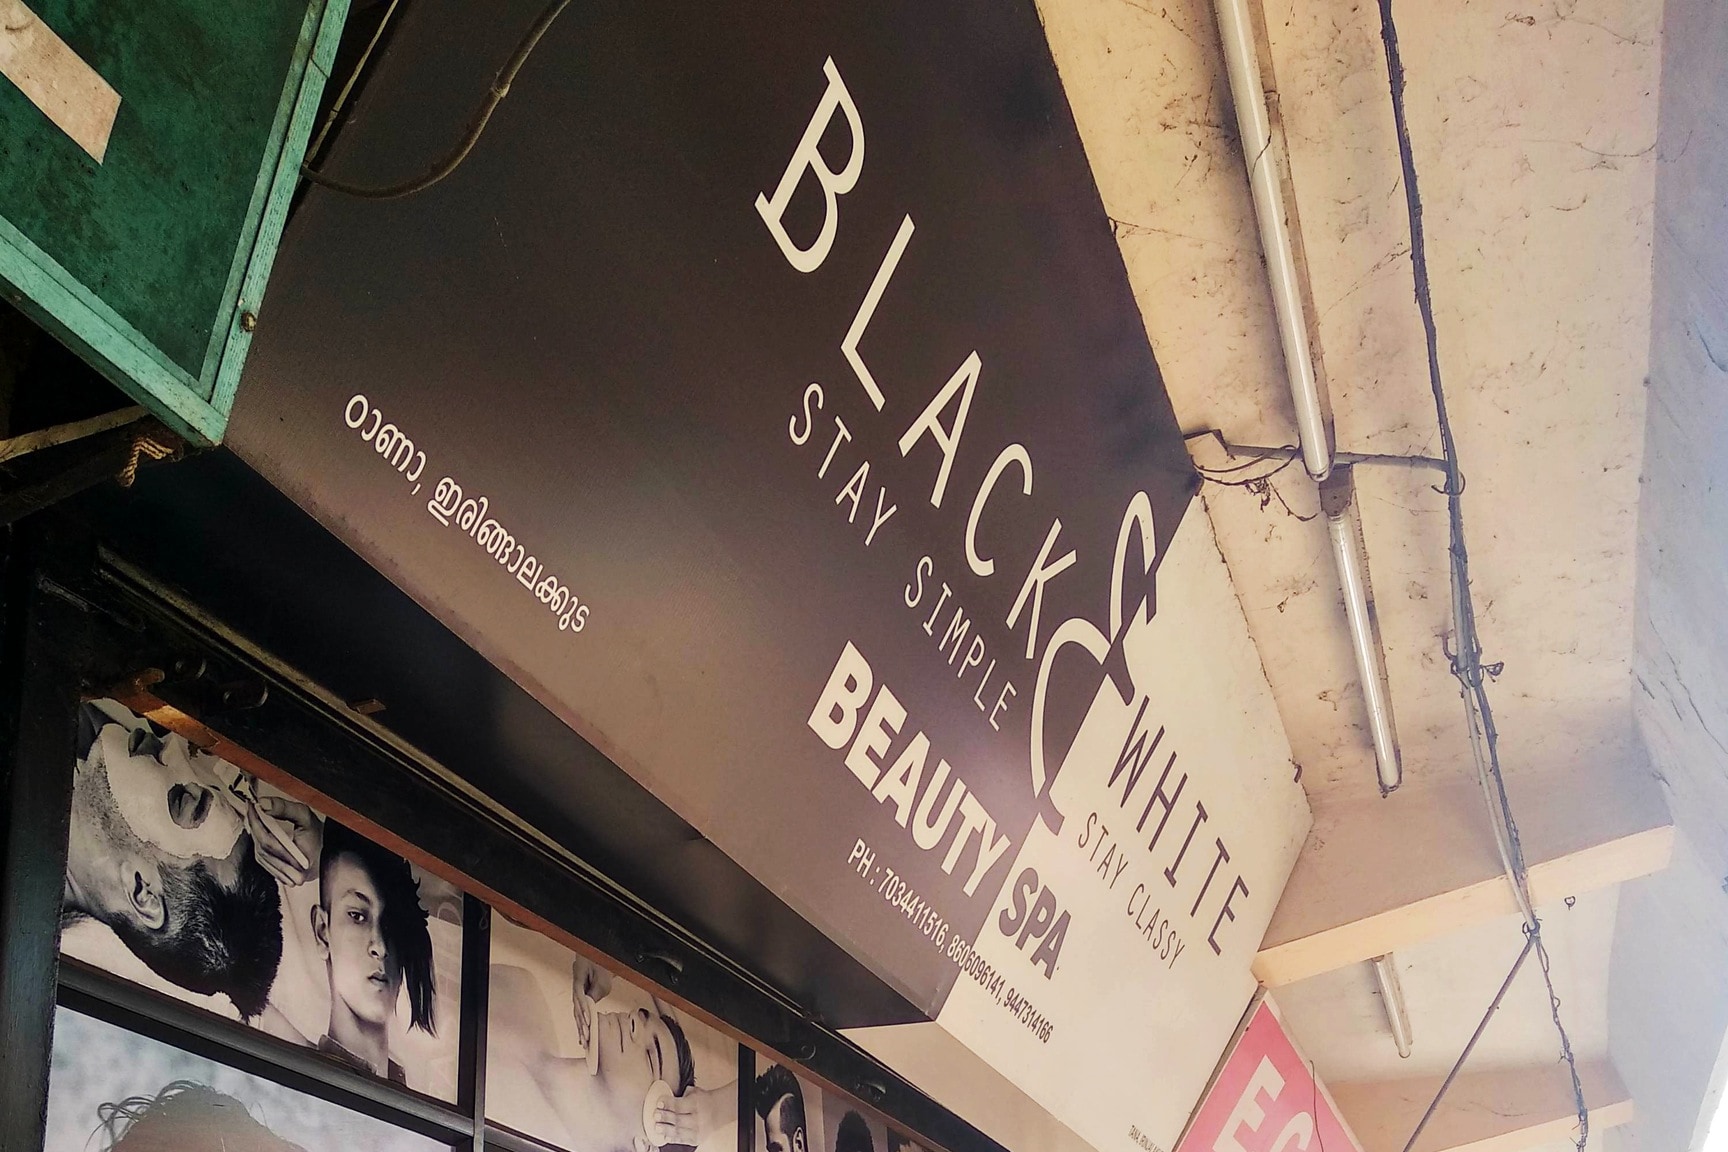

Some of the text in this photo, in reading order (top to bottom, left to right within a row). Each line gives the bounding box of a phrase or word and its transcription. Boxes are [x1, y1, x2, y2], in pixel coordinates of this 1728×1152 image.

[755, 55, 1077, 659] BLACK
[789, 382, 1017, 731] STAY SIMPLE
[807, 640, 1072, 981] BEAUTY SPA
[1078, 812, 1186, 970] STAY CLASSY
[1108, 695, 1249, 956] WHITE
